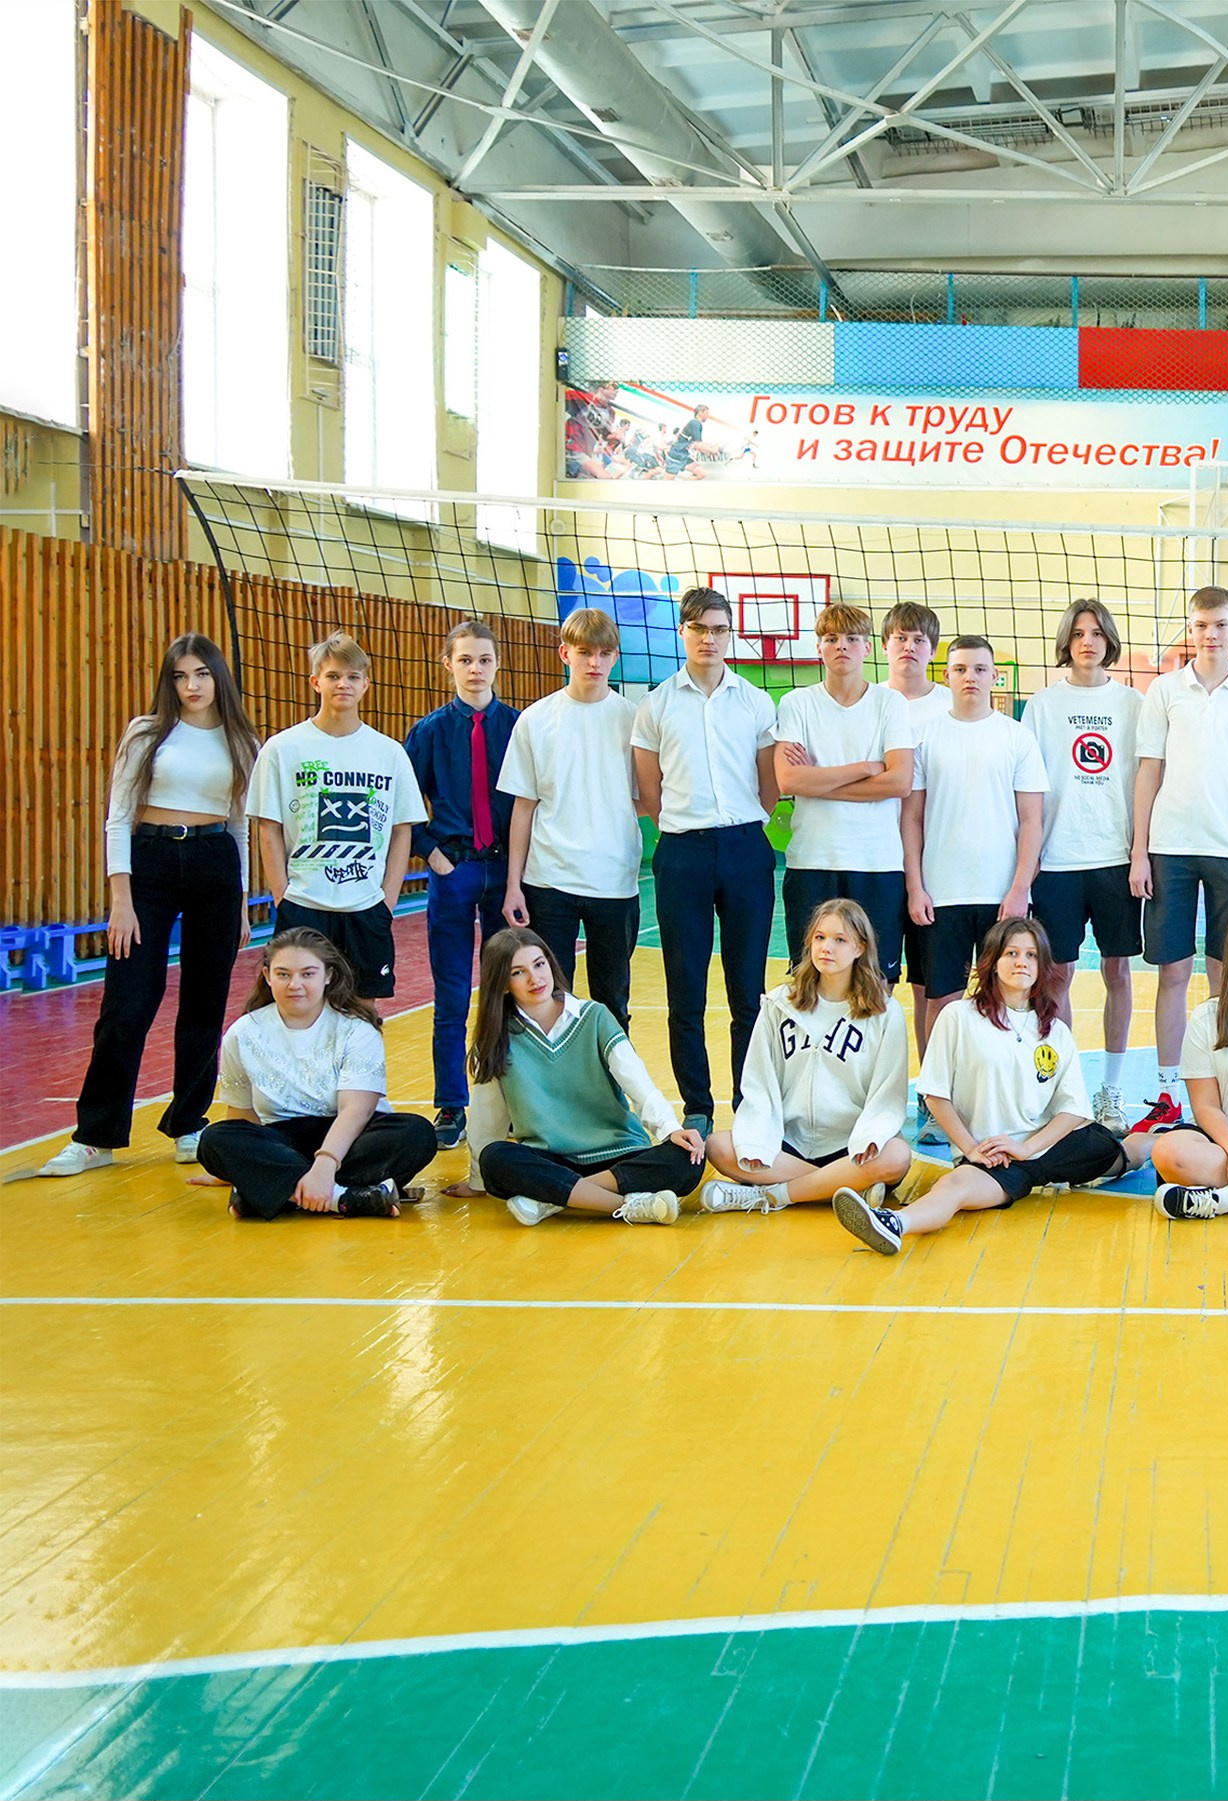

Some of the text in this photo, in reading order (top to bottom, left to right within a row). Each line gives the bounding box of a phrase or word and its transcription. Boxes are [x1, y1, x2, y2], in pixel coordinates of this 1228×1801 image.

[749, 395, 1014, 435] Готов к труду
[796, 438, 820, 460] и
[833, 438, 985, 467] защите
[999, 434, 1220, 468] Отечества!
[1067, 715, 1113, 726] VETEMENTS
[301, 759, 330, 772] FREE
[323, 771, 393, 791] CONNECT
